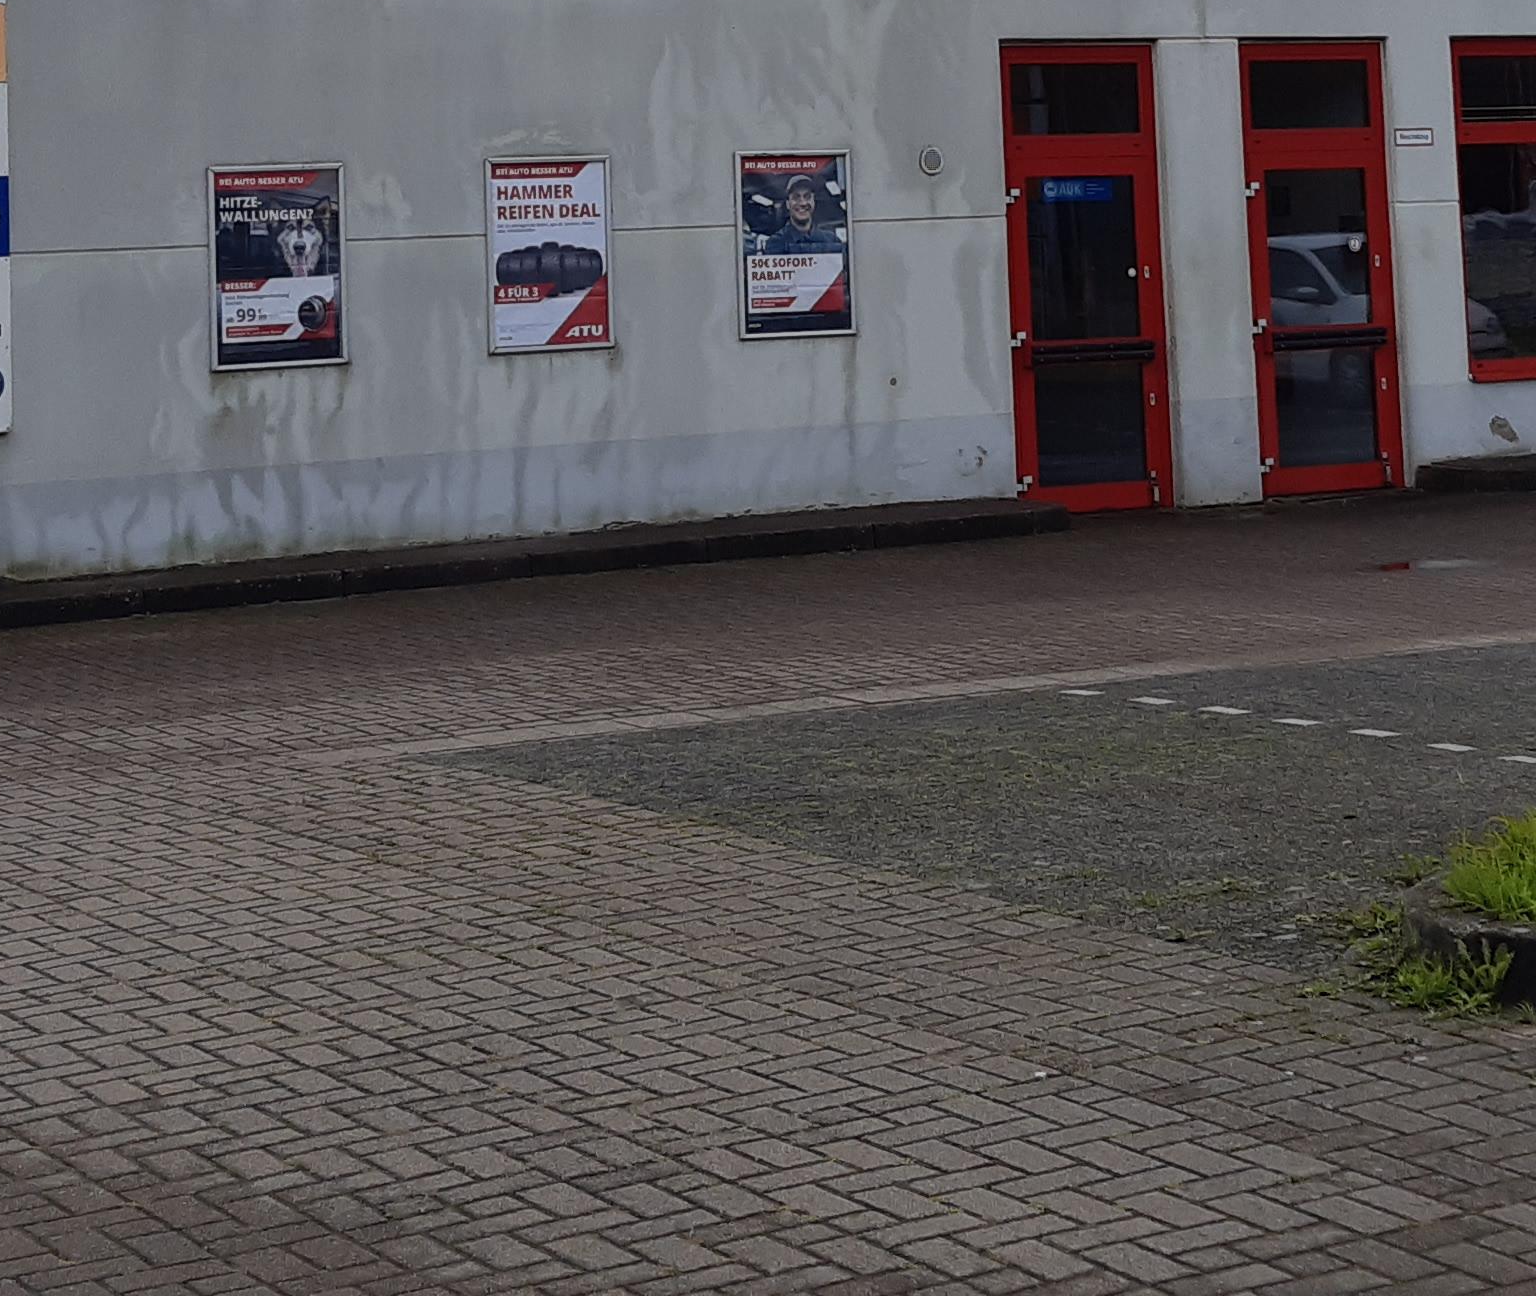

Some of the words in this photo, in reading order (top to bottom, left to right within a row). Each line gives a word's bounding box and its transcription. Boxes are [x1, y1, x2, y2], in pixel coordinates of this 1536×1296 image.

[509, 167, 530, 175] AUTO
[756, 161, 776, 169] AUTO
[233, 176, 256, 185] AUTO
[496, 184, 574, 201] HAMMER
[220, 196, 262, 209] HITZE-
[219, 208, 314, 223] WALLUNGEN?
[497, 205, 554, 221] REIFEN
[559, 203, 601, 218] DEAL
[751, 258, 770, 269] 50€
[772, 256, 817, 268] SOFORT-
[498, 288, 506, 298] 4
[507, 285, 530, 298] FÜR
[531, 287, 539, 297] 3
[236, 308, 256, 322] 99
[565, 324, 604, 338] ATU
